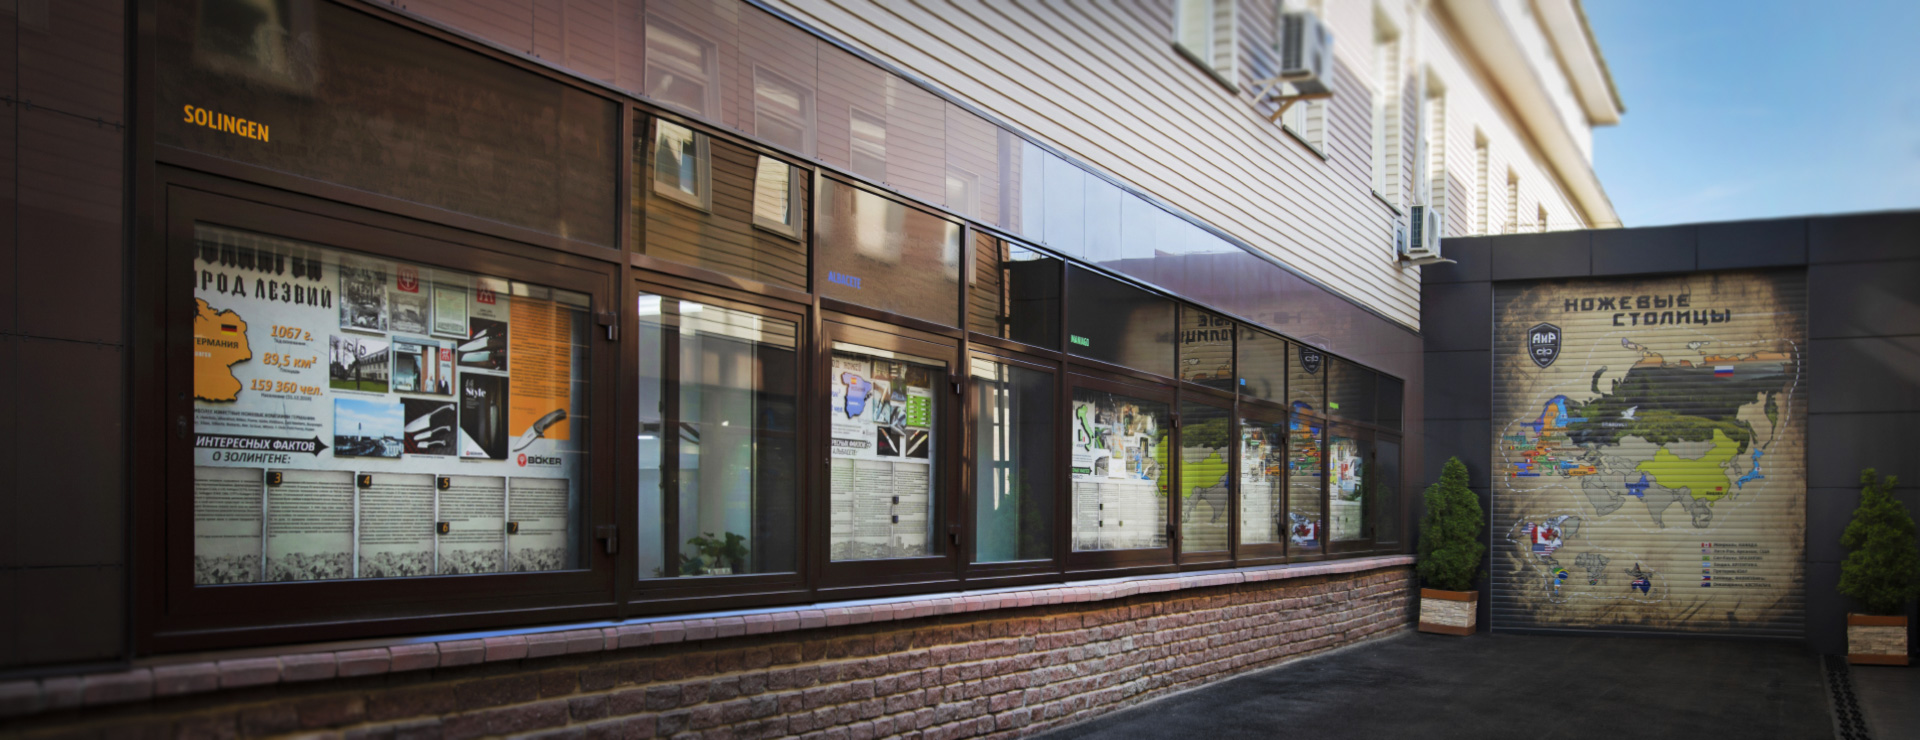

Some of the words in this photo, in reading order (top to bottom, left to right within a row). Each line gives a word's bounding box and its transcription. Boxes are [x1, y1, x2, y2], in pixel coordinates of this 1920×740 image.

[184, 104, 269, 142] SOLINGEN
[828, 270, 861, 290] ALBACETE
[255, 277, 332, 309] ЛЕЗВИЙ
[1564, 294, 1690, 312] НОЖЕВЫЕ
[1612, 309, 1731, 327] СТОЛИЦЫ
[270, 325, 301, 340] 1067
[263, 352, 290, 368] 89,5
[250, 379, 273, 392] 159
[275, 380, 297, 393] 360
[465, 387, 487, 399] Style
[195, 435, 270, 450] ИНТЕРЕСНЫХ
[272, 437, 315, 452] ФАКТОВ
[212, 451, 222, 462] О
[224, 451, 291, 464] ЗОЛИНГЕНЕ:
[274, 472, 281, 484] 3
[363, 475, 370, 485] 4
[443, 478, 449, 488] 5
[443, 523, 448, 533] 6
[512, 522, 518, 532] 7
